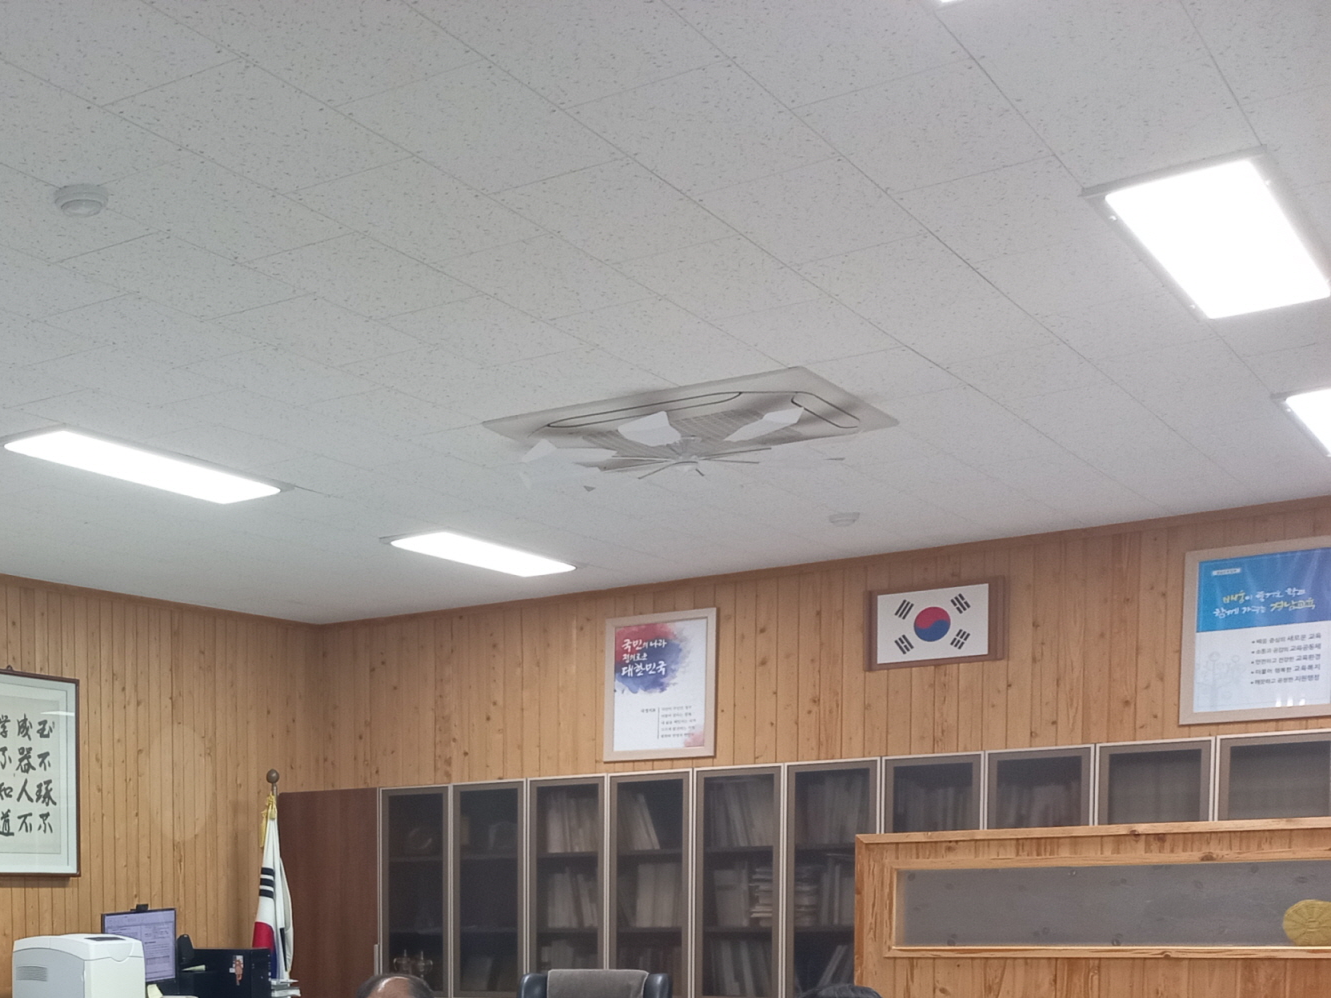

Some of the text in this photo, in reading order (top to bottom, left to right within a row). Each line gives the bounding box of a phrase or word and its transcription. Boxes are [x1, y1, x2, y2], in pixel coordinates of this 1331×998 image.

[622, 639, 667, 652] 국민의 나라
[622, 653, 648, 663] 정의로운
[621, 661, 667, 677] 대한민국
